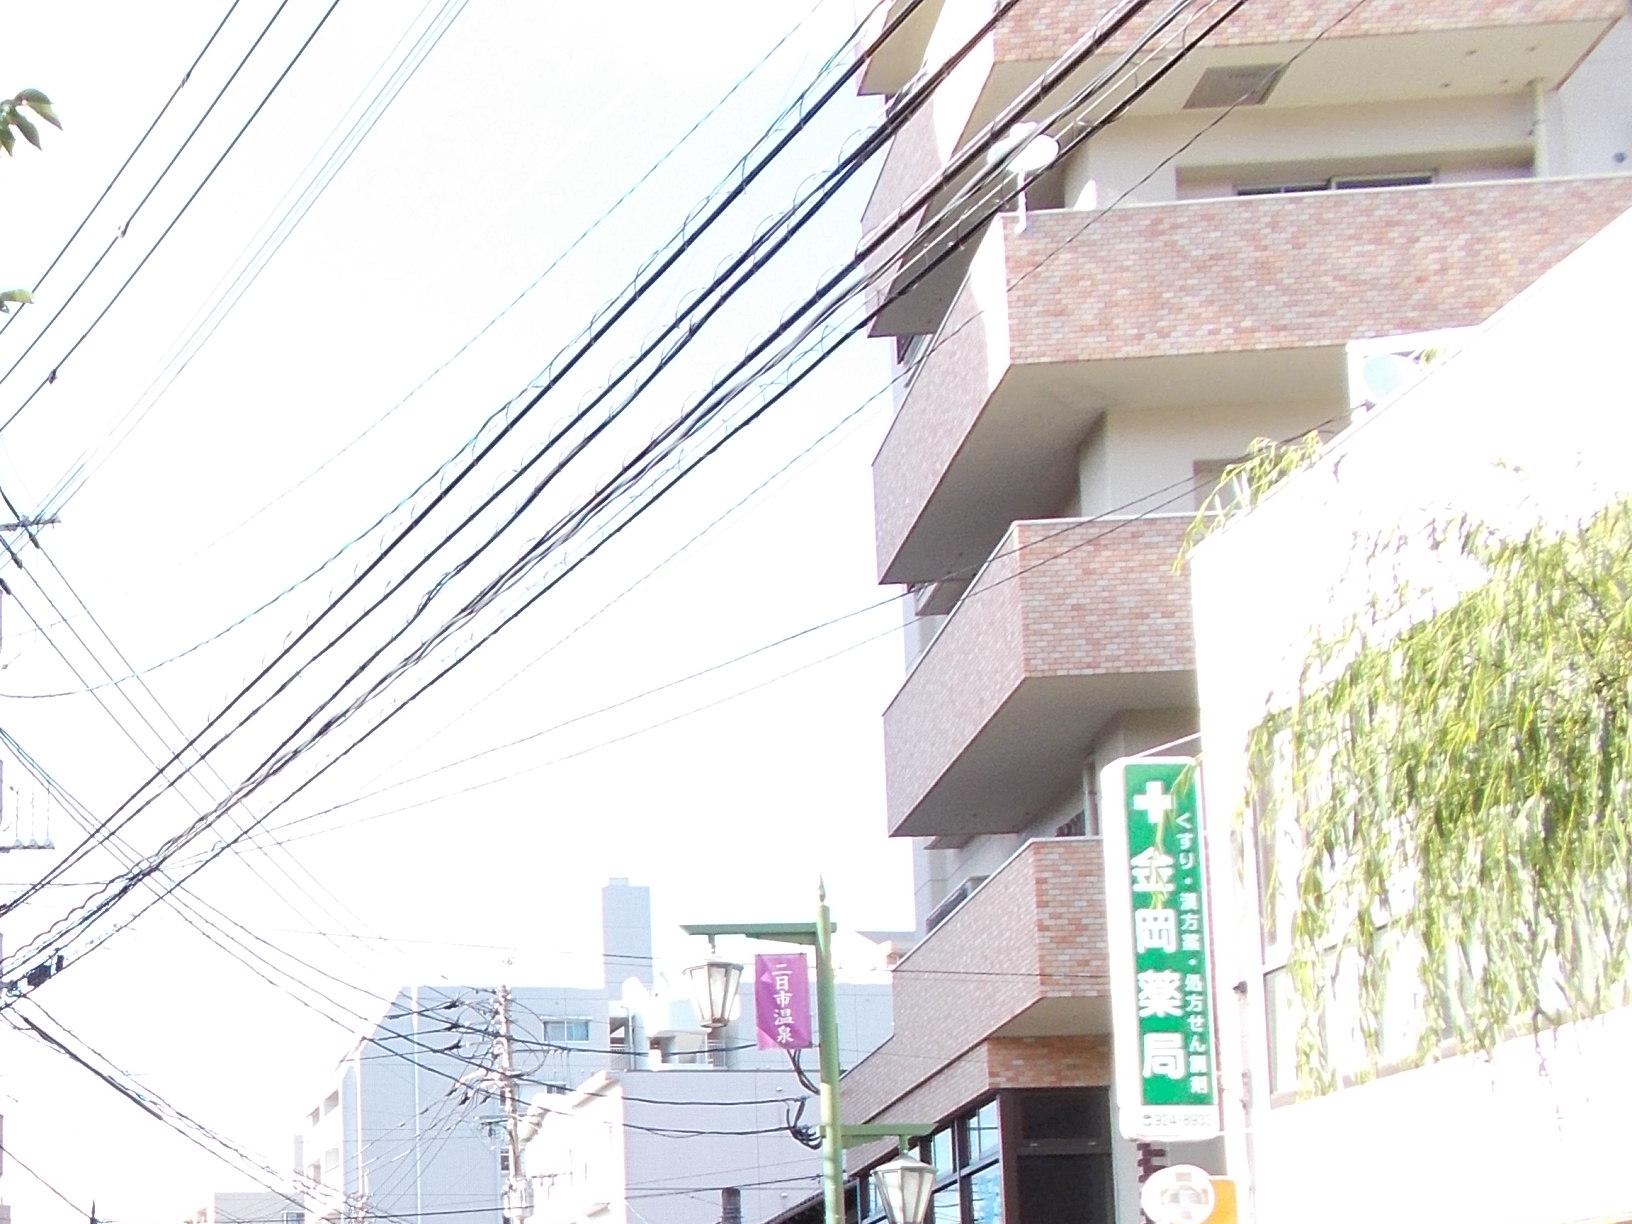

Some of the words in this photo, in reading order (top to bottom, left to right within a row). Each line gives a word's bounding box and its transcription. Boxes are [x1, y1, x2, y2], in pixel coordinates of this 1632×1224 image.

[771, 963, 795, 1044] 二日市温泉
[1130, 846, 1185, 1080] 金岡薬局
